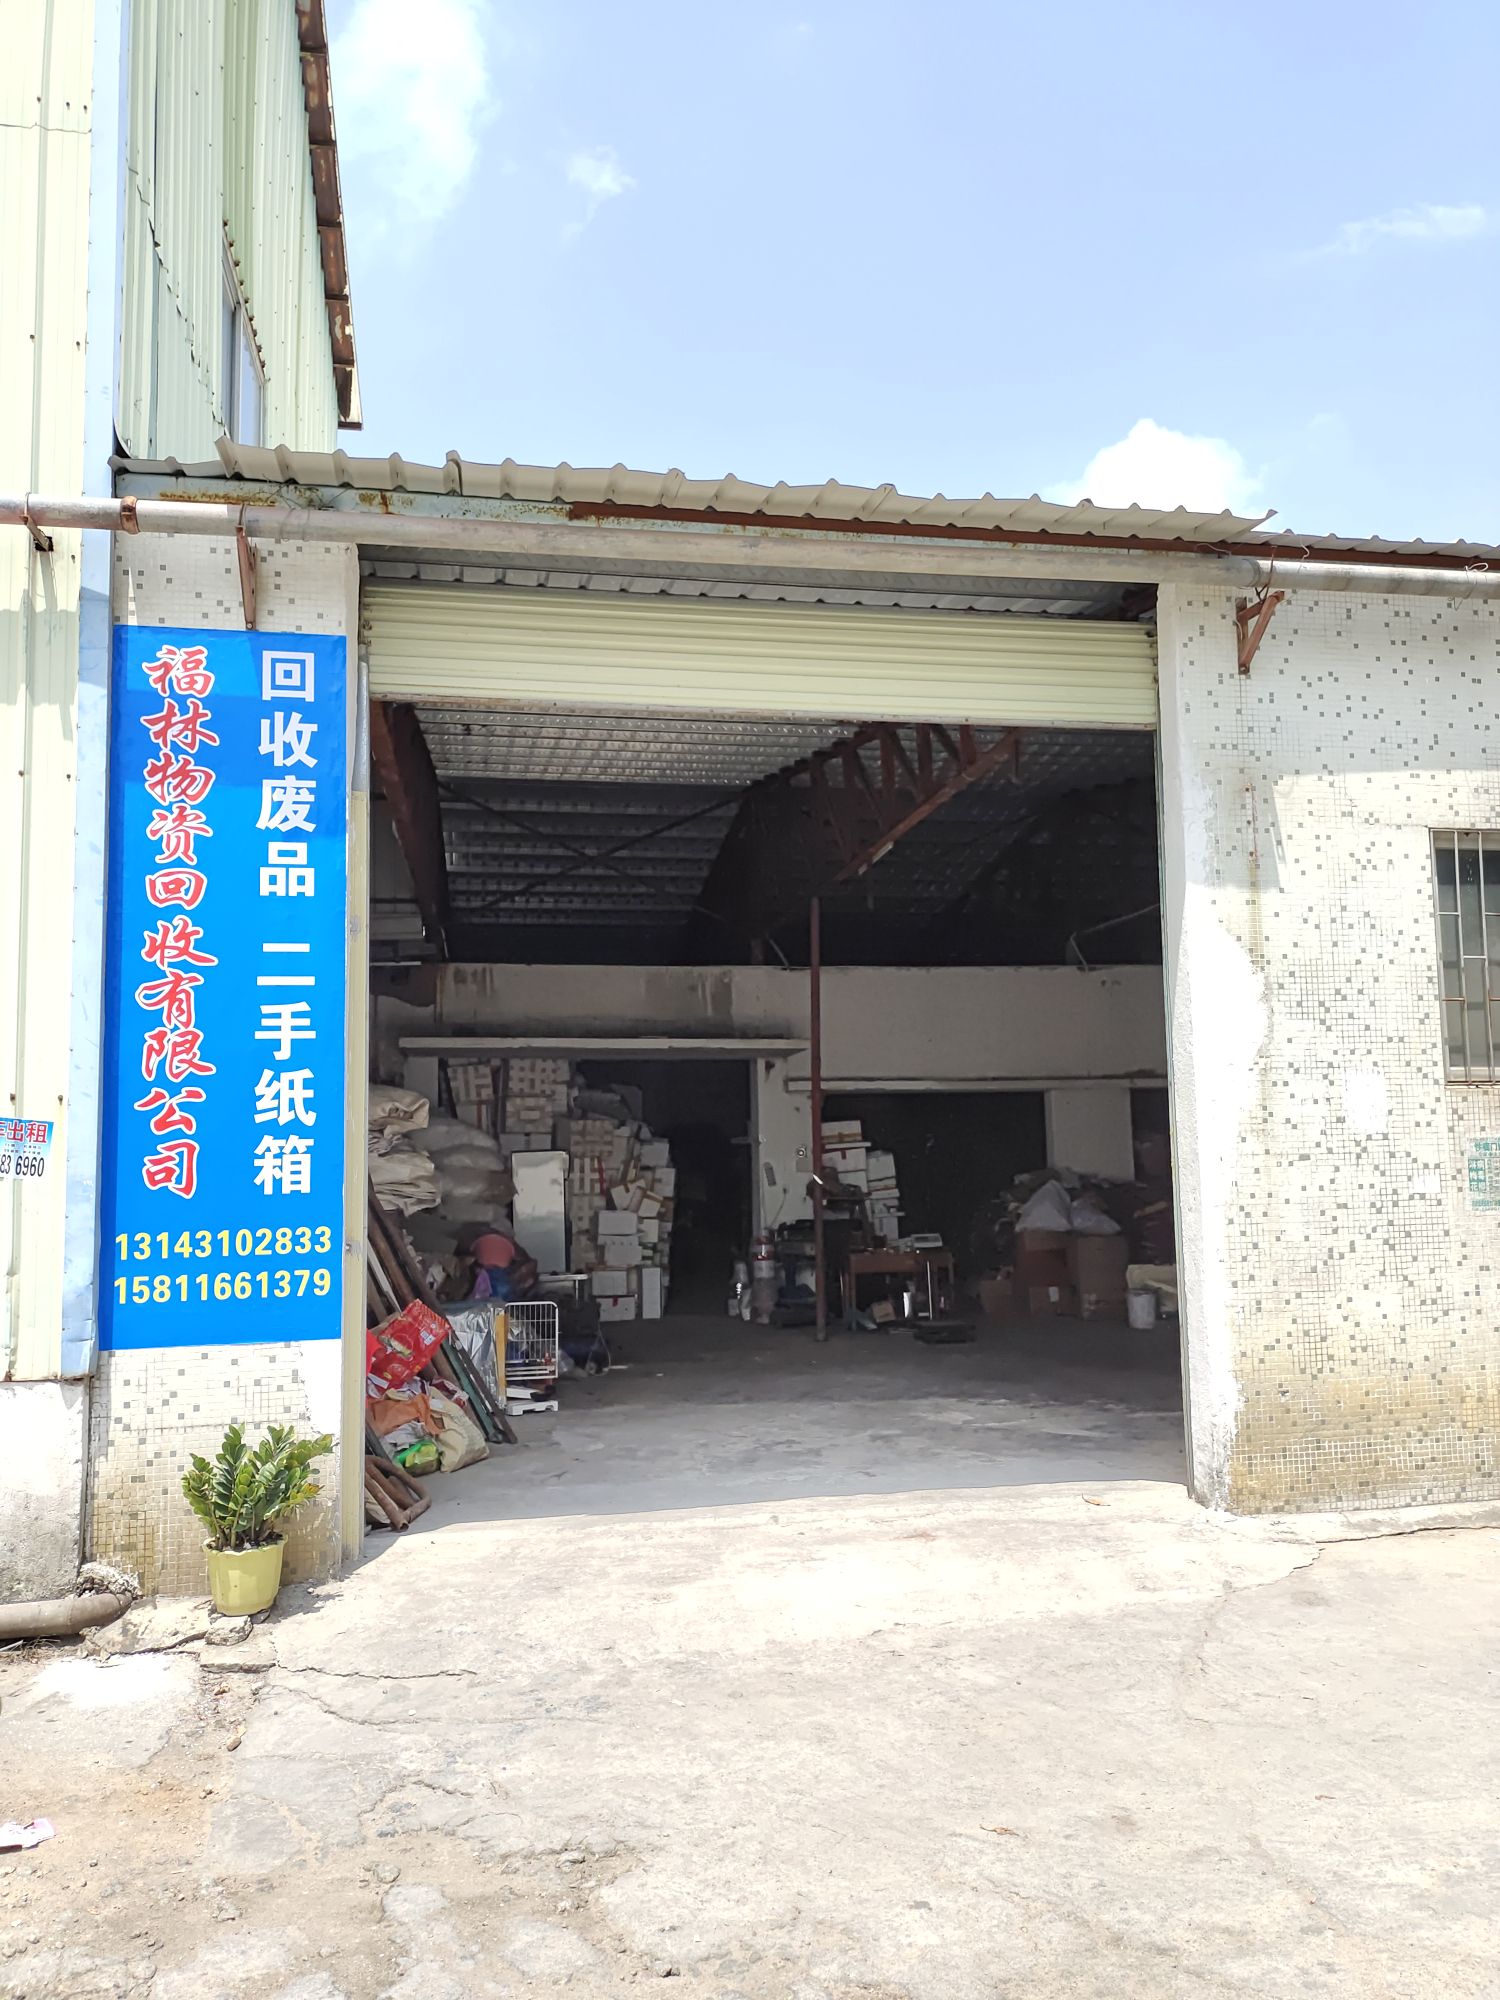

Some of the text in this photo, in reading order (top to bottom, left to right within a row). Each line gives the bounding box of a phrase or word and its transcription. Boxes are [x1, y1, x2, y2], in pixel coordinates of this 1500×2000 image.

[134, 645, 220, 1199] 福林物资回收有限公司
[254, 650, 319, 1195] 回收废品 二手纸箱
[15, 1155, 45, 1177] 6960
[115, 1226, 332, 1261] 13143102833
[114, 1268, 331, 1305] 15811661379
